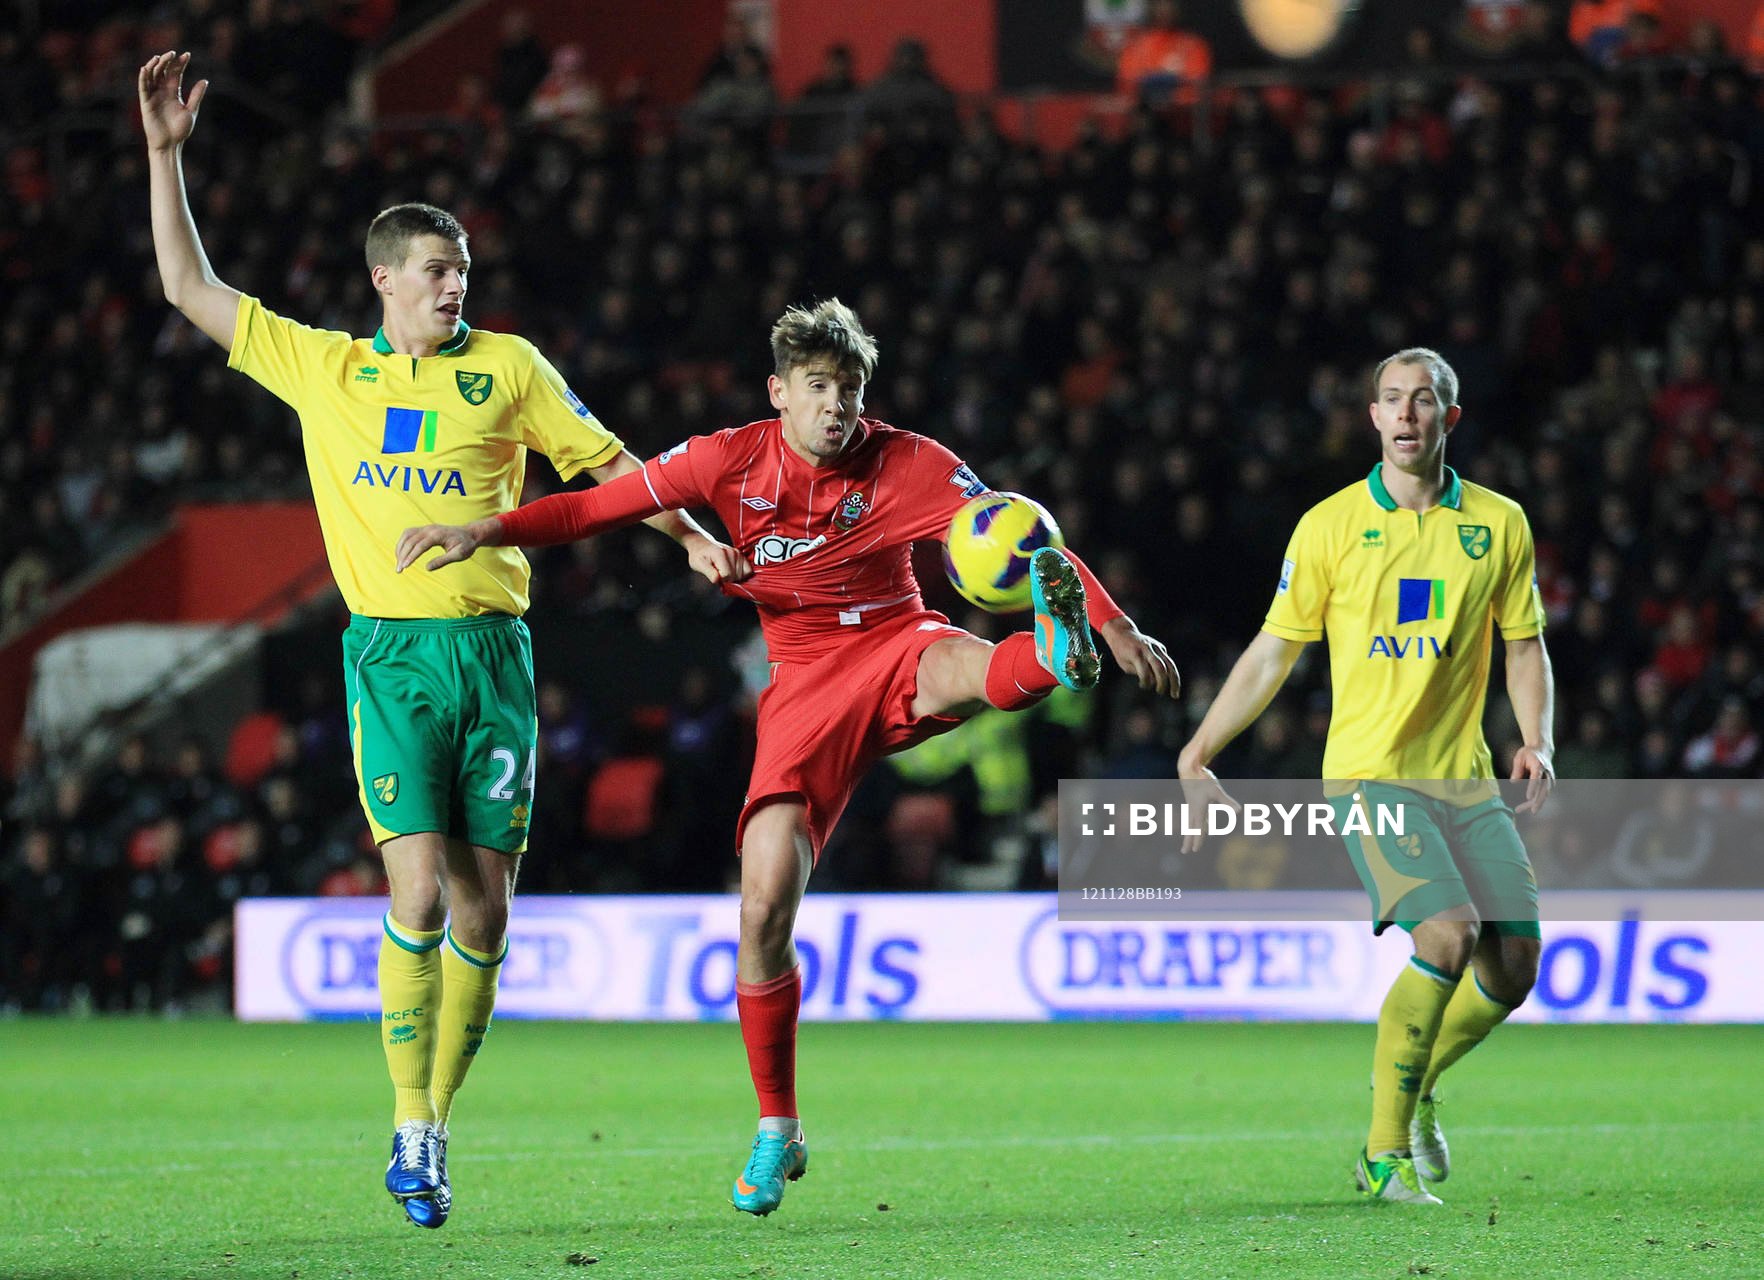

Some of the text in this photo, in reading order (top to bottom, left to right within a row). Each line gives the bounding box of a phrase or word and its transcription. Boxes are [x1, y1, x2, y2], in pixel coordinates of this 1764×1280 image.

[352, 461, 467, 496] AVIVA
[487, 747, 536, 803] 24
[1060, 931, 1335, 989] DRAPER
[384, 1007, 425, 1021] NCFC
